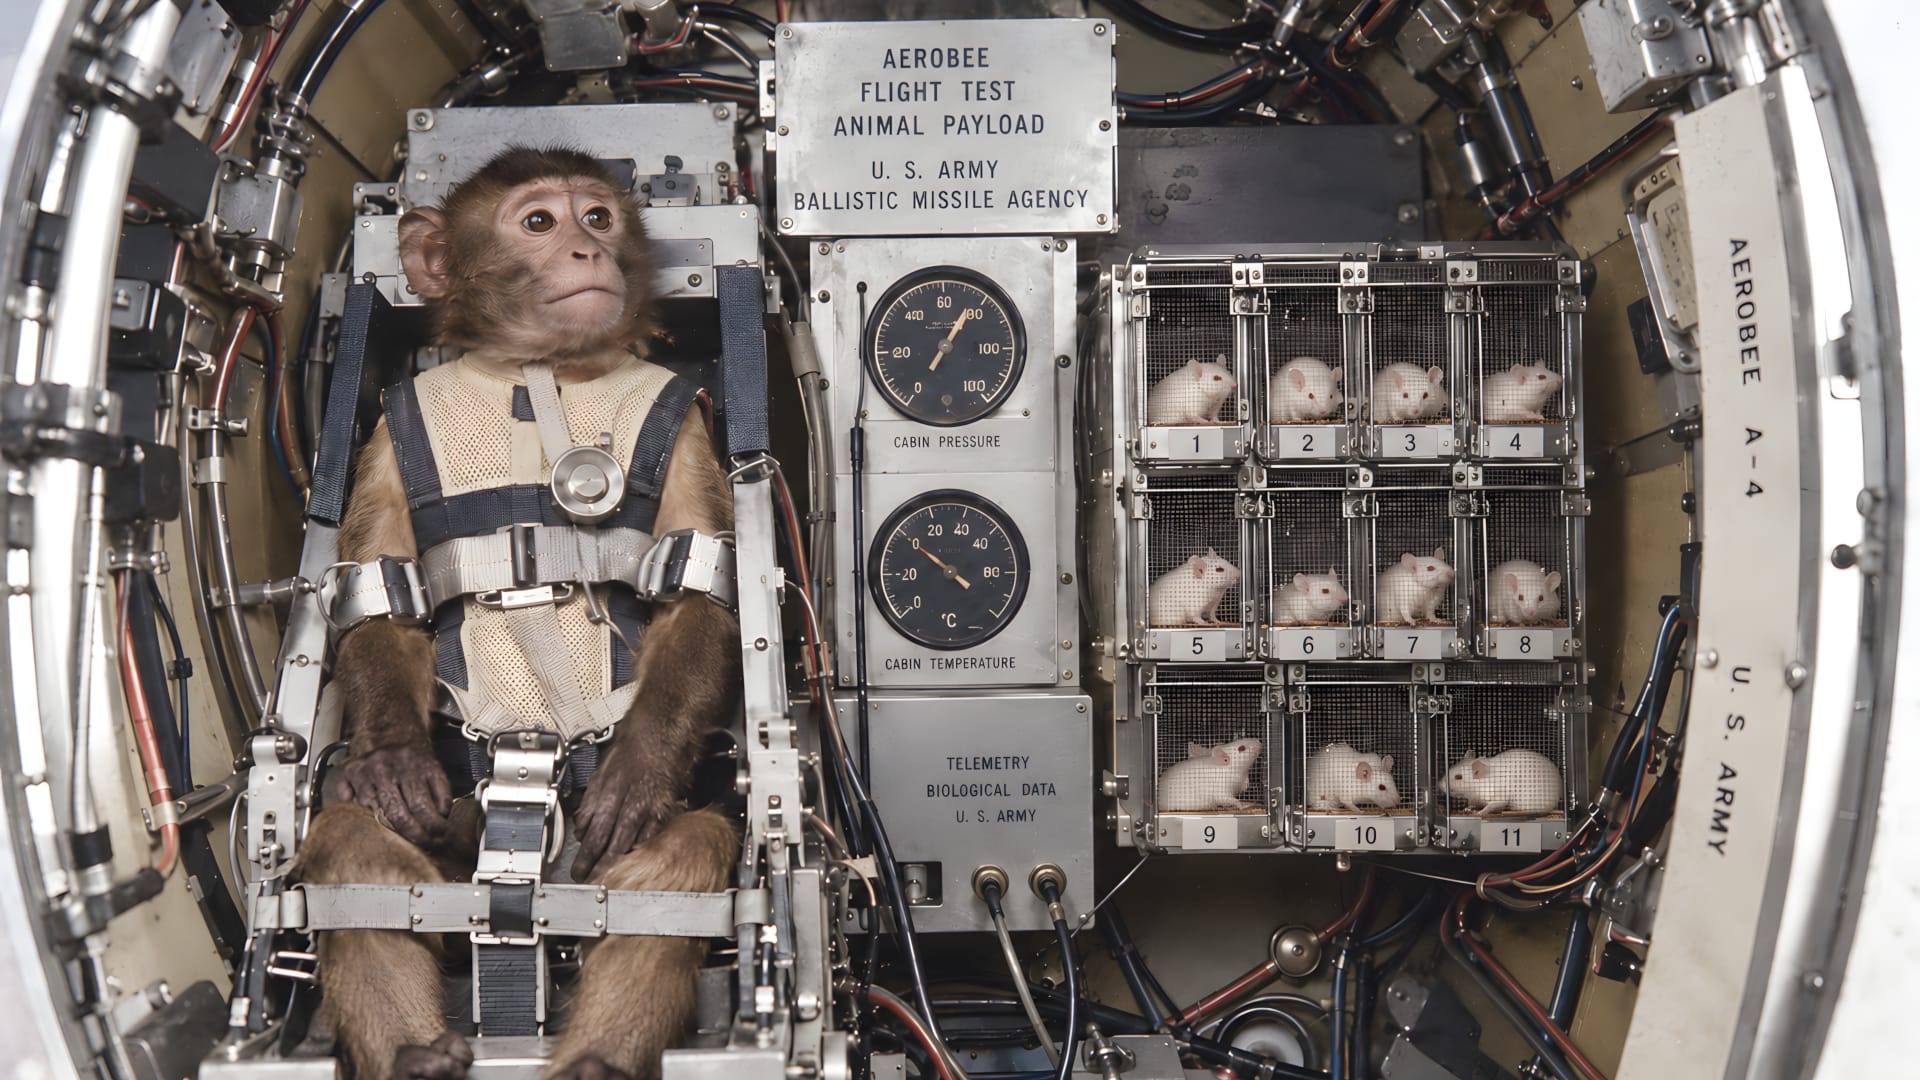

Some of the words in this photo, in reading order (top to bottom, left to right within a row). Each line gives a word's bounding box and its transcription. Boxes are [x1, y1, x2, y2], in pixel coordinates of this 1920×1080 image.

[882, 47, 989, 69] AEROBEE
[861, 81, 942, 103] FLIGHT
[960, 80, 1016, 102] TEST
[833, 115, 925, 137] ANIMAL
[943, 113, 1044, 136] PAYLOAD
[872, 160, 890, 180] U.
[904, 160, 922, 180] S.
[938, 159, 998, 179] ARMY
[794, 191, 898, 211] BALLISTIC
[912, 190, 994, 210] MISSILE
[1007, 189, 1088, 209] AGENCY
[937, 296, 952, 309] 60
[1730, 239, 1761, 385] AEROBEE
[980, 343, 1000, 355] 100
[914, 382, 922, 394] 0
[894, 436, 930, 448] CABIN
[939, 435, 1001, 448] PRESSURE
[1192, 434, 1200, 453] 1
[1302, 434, 1315, 453] 2
[1404, 434, 1417, 453] 3
[1509, 433, 1523, 452] 4
[928, 525, 943, 537] 20
[954, 523, 970, 536] 40
[912, 537, 921, 550] 0
[972, 537, 988, 550] 40
[913, 595, 921, 609] 0
[1192, 636, 1204, 655] 5
[1302, 635, 1315, 654] 6
[1407, 636, 1419, 654] 7
[1519, 635, 1532, 654] 8
[885, 658, 921, 671] CABIN
[929, 656, 1016, 670] TEMPERATURE
[1731, 666, 1751, 692] U.
[1724, 713, 1745, 740] S.
[946, 755, 1030, 771] TELEMETRY
[926, 783, 1011, 798] BIOLOGICAL
[1022, 782, 1057, 796] DATA
[956, 809, 969, 824] U.
[977, 809, 990, 823] S.
[996, 808, 1036, 823] ARMY
[1707, 762, 1737, 856] ARMY
[1203, 826, 1216, 844] 9
[1354, 826, 1377, 845] 10
[1501, 828, 1521, 847] 11
